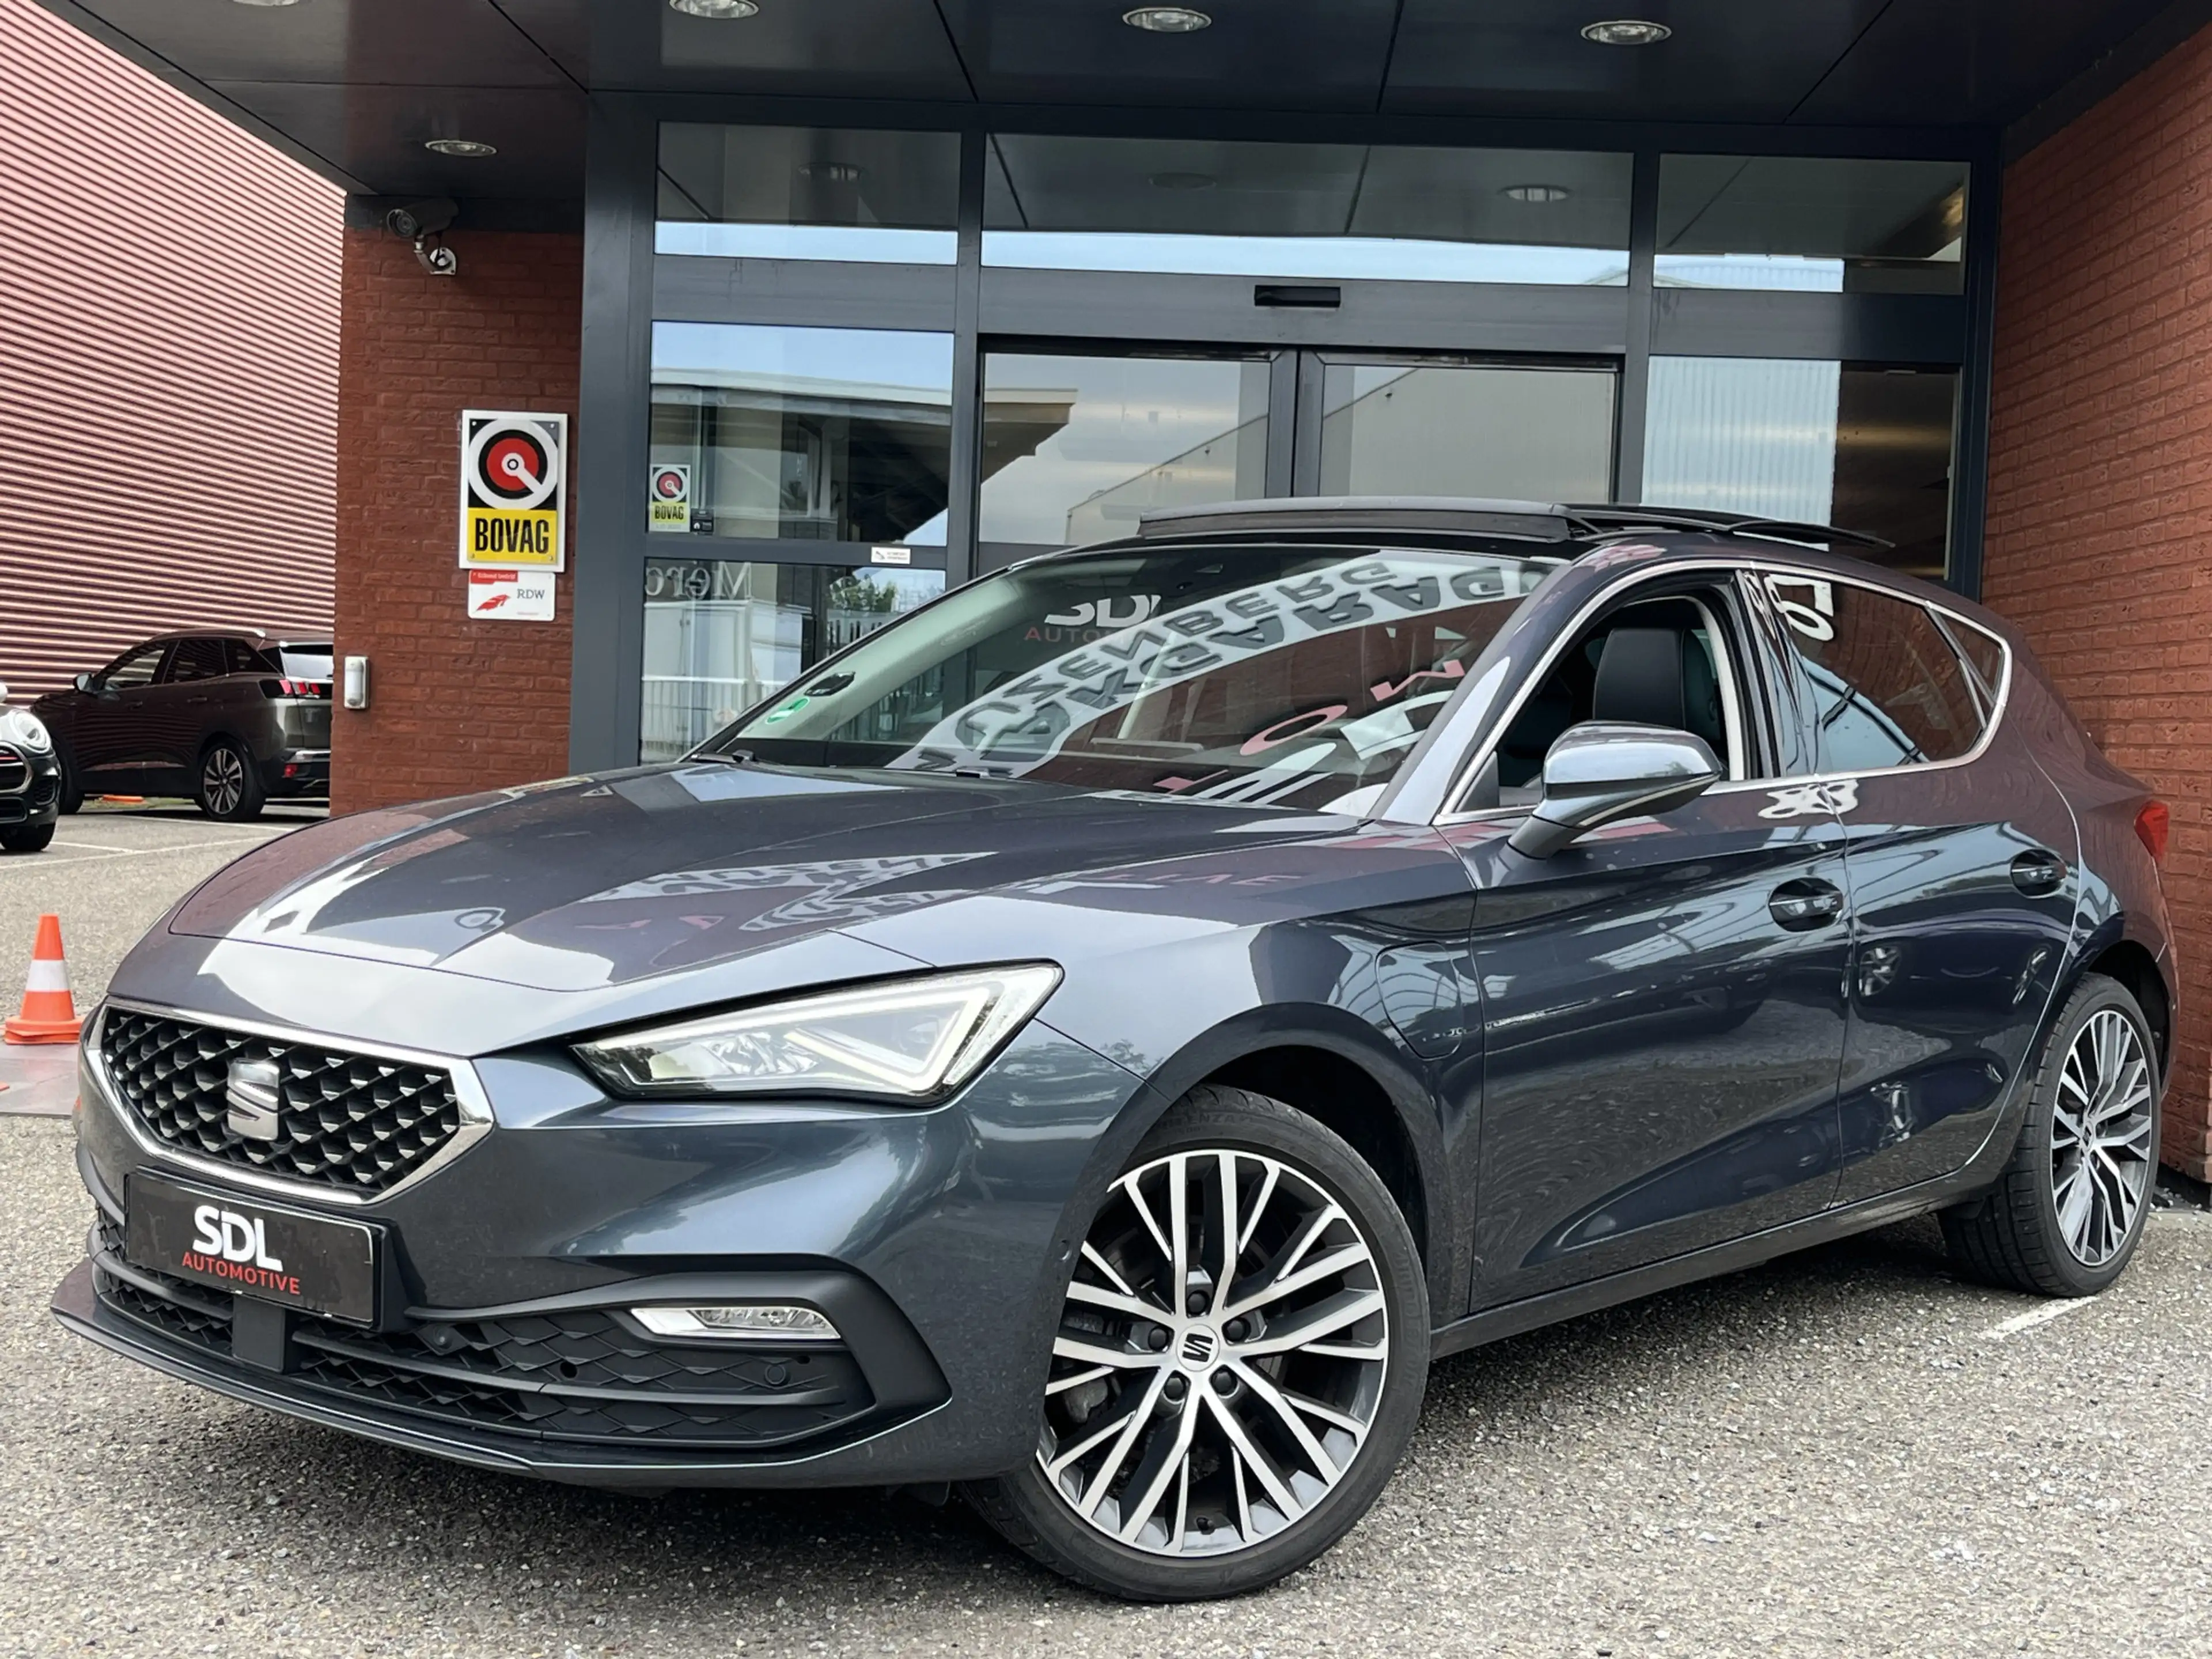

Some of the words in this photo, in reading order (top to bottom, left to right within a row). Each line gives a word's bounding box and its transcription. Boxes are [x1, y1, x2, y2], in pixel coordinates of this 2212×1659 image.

[655, 505, 684, 520] BOVAG
[475, 517, 550, 554] BOVAG
[517, 589, 545, 600] RDW
[192, 1205, 283, 1272] SDL
[182, 1251, 300, 1295] AUTOMOTIVE
